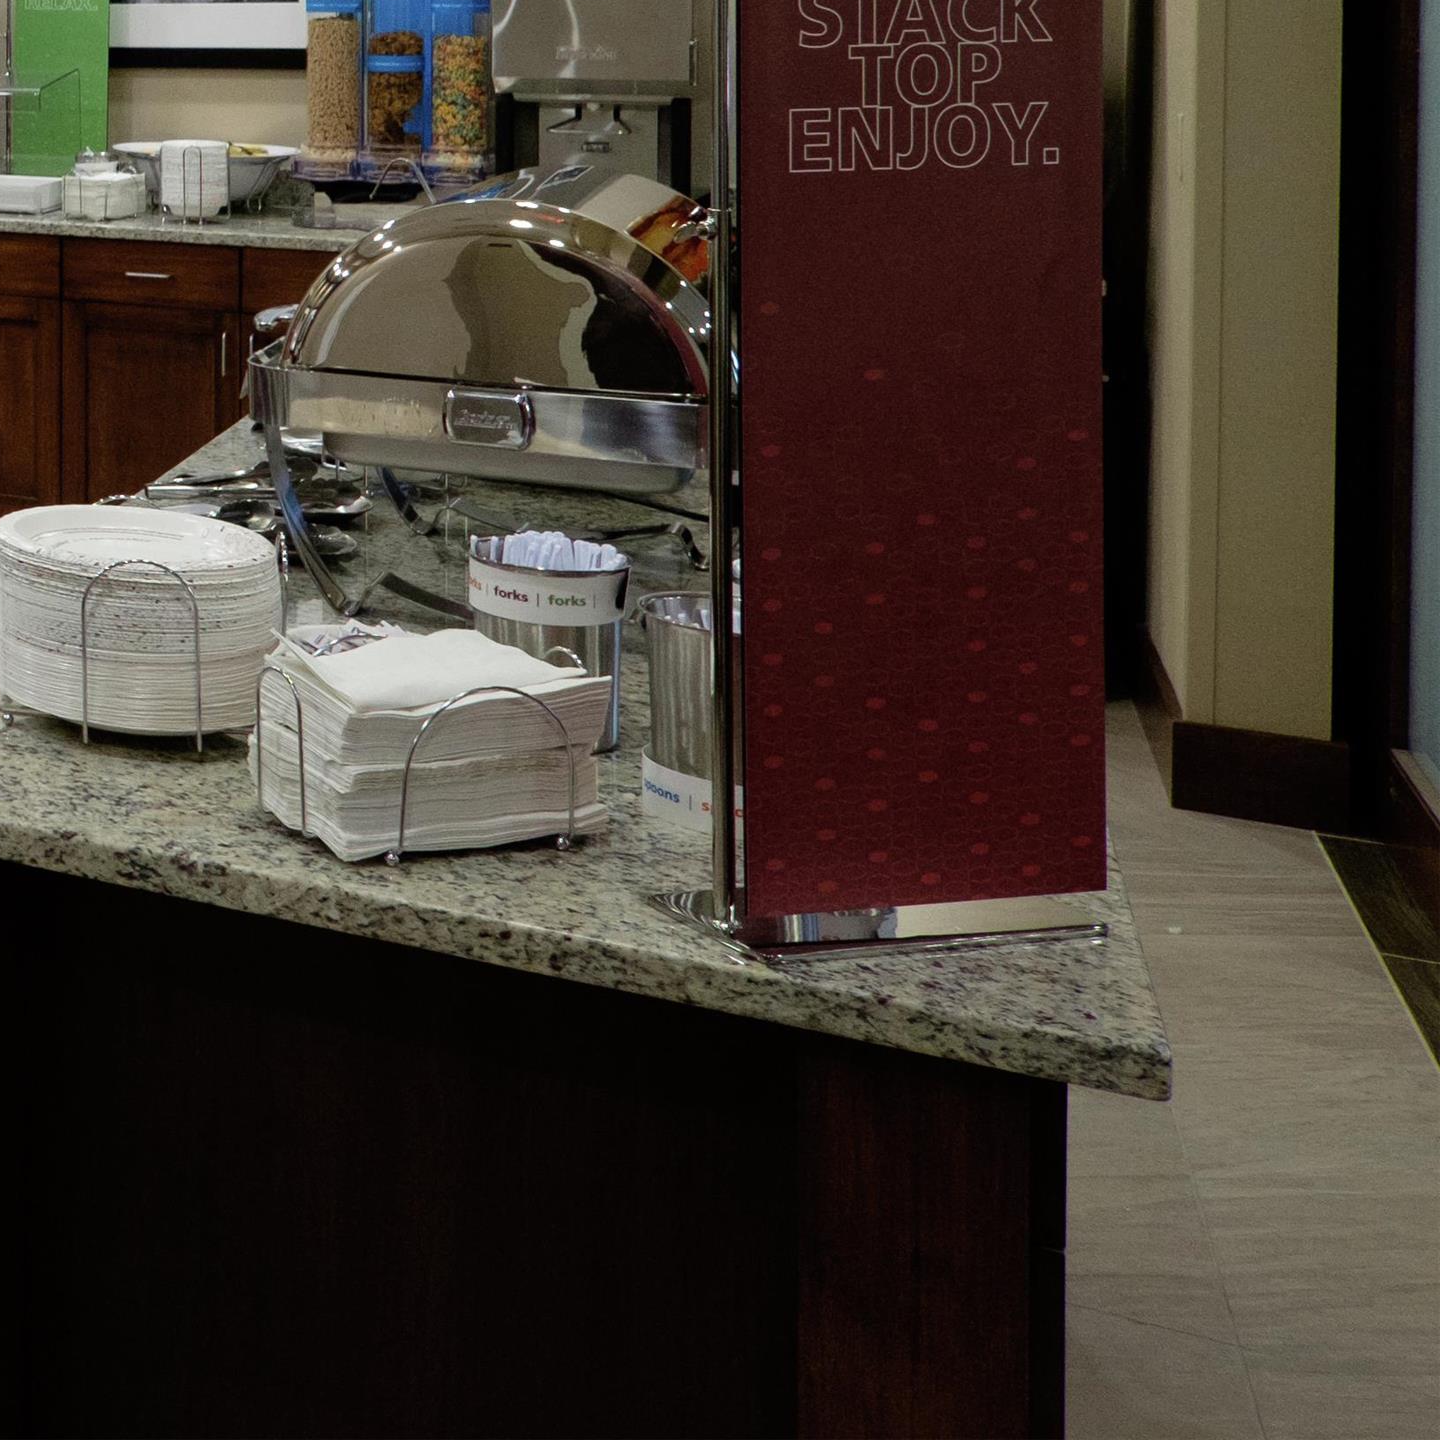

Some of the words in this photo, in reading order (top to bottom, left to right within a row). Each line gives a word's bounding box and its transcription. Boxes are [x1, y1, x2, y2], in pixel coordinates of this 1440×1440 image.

[847, 41, 1003, 109] TOP
[787, 101, 1061, 174] ENJOY.
[493, 585, 529, 603] forks
[547, 594, 587, 608] forks
